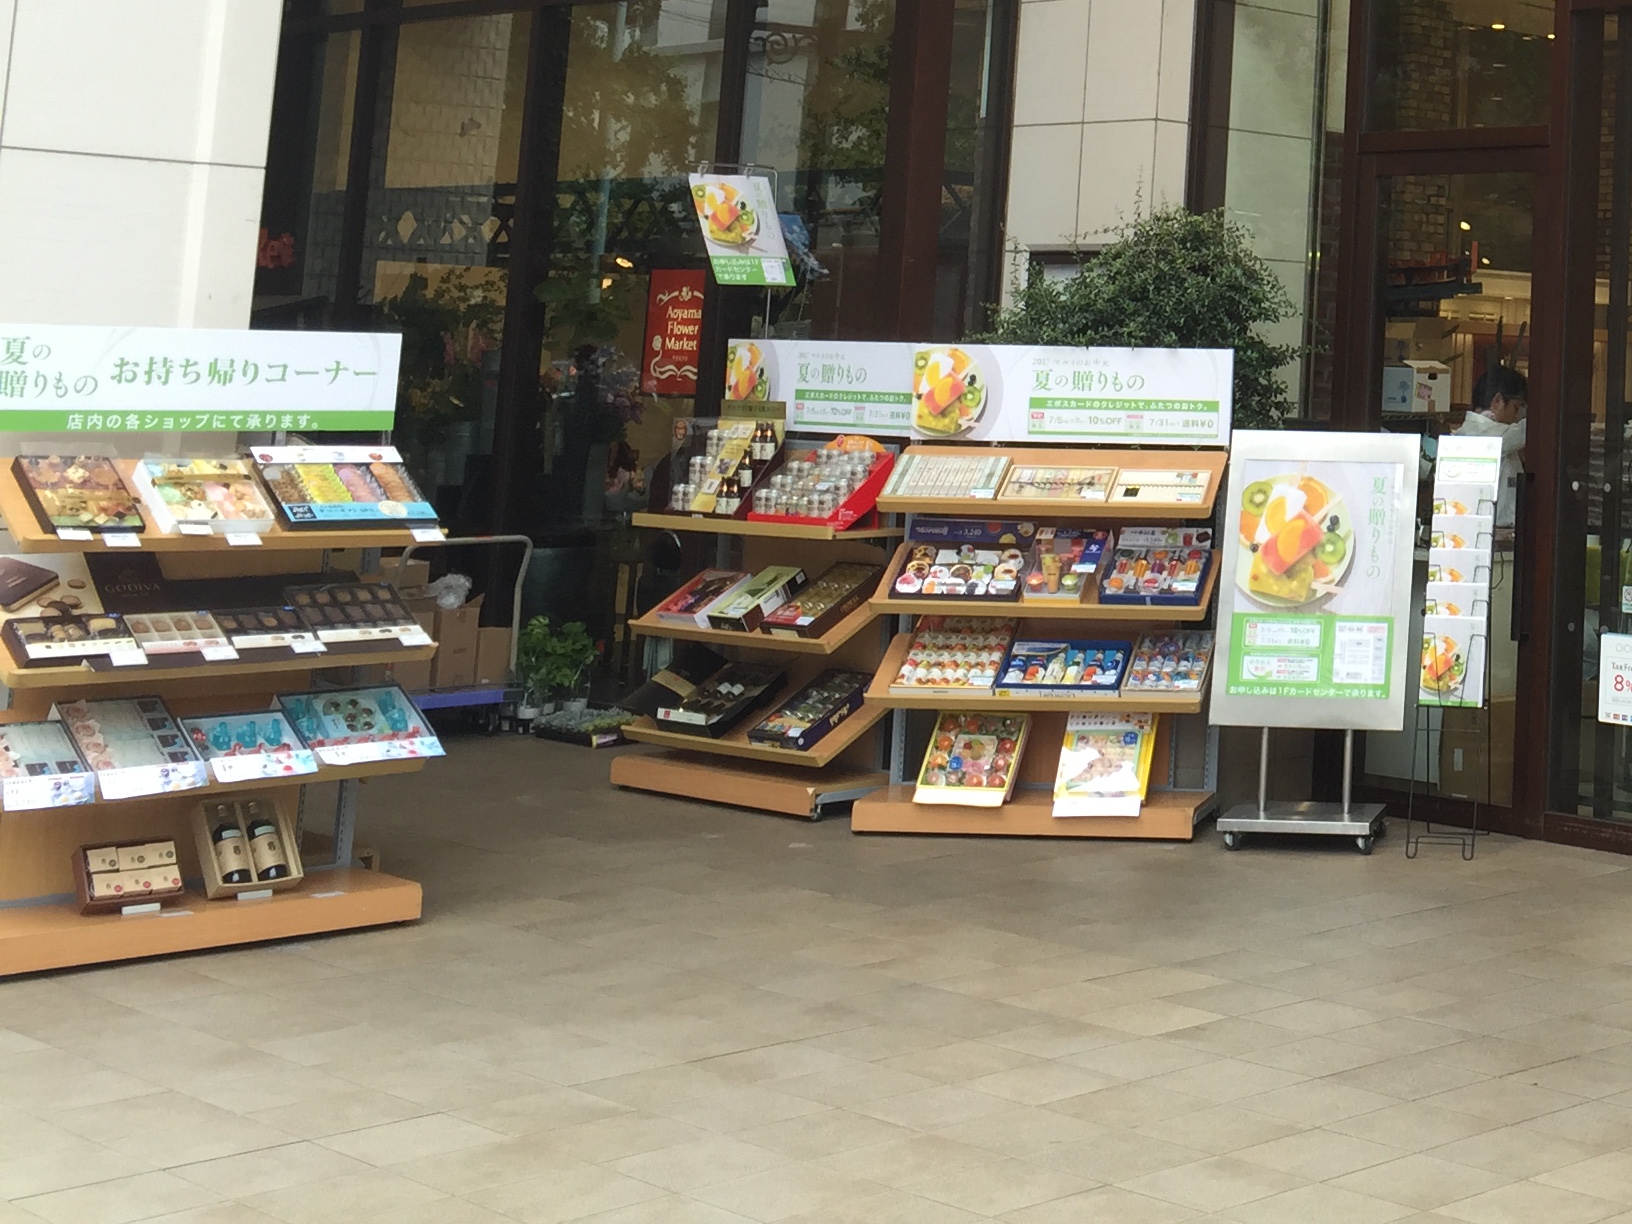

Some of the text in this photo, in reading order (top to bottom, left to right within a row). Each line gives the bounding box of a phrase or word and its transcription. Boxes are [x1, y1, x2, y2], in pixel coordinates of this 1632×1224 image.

[666, 305, 702, 322] Aoyama
[667, 321, 699, 335] Flower
[1, 336, 52, 366] 夏の
[665, 336, 697, 351] Market
[110, 356, 379, 388] お持ち帰りコーナー
[797, 362, 867, 385] 夏の贈りもの
[1032, 368, 1145, 393] 夏の贈りもの
[0, 369, 99, 399] 贈りもの
[66, 412, 319, 431] 店内の各ショップにて承ります。
[1366, 476, 1387, 580] 夏の贈りもの
[104, 583, 161, 594] GODIVA
